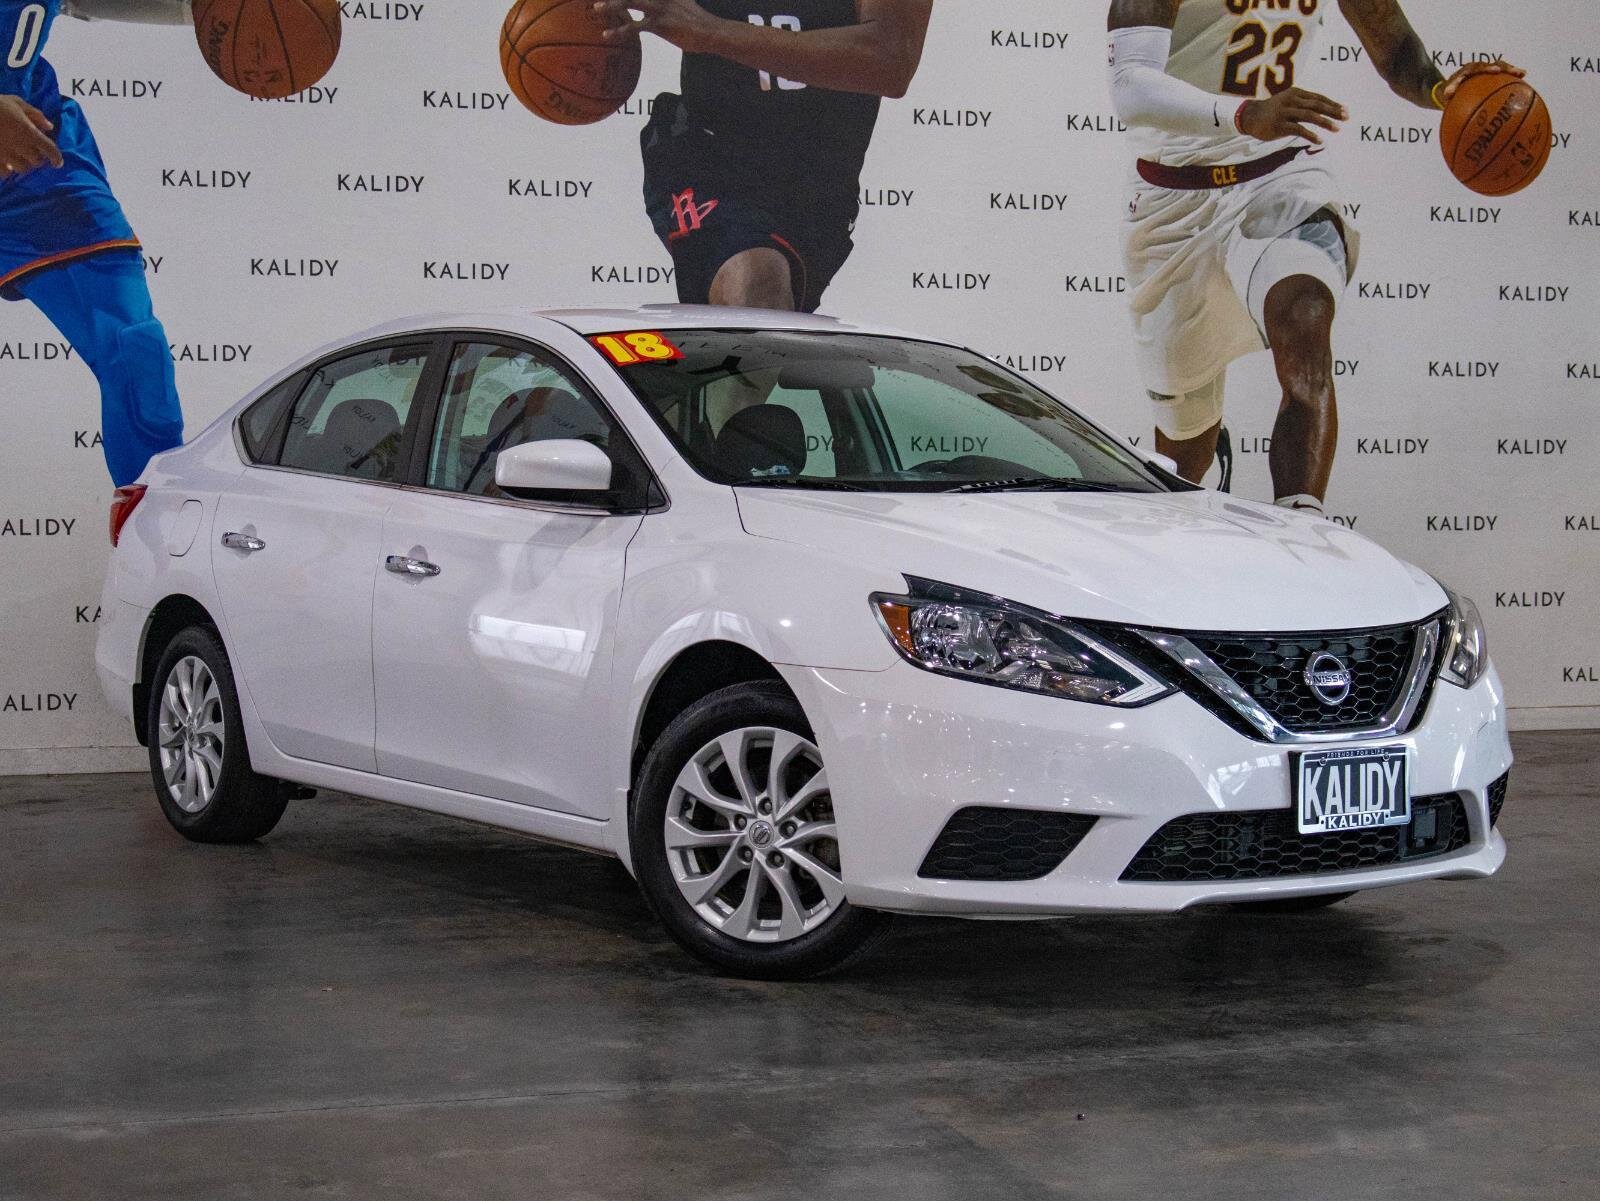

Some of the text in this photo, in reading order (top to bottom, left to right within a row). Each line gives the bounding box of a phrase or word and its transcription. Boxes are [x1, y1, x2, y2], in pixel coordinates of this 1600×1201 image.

[340, 1, 425, 22] KALIDY
[7, 3, 46, 68] 0
[991, 29, 1069, 49] KALIDY
[1220, 20, 1303, 98] 23
[1320, 45, 1362, 63] IDY
[71, 79, 163, 98] KALIDY
[250, 87, 338, 104] IDY
[423, 90, 510, 111] KALIDY
[913, 108, 992, 128] KALIDY
[1360, 125, 1433, 144] KALIDY
[162, 168, 252, 189] KALIDY
[337, 173, 425, 193] KALIDY
[1212, 167, 1237, 185] CLE
[508, 178, 593, 198] KALIDY
[859, 189, 915, 206] LIDY
[990, 192, 1068, 211] KALIDY
[1430, 206, 1502, 224] KALIDY
[1568, 210, 1600, 227] KAL
[250, 258, 339, 277] KALIDY
[423, 261, 510, 281] KALIDY
[591, 265, 673, 284] KALIDY
[912, 272, 991, 291] KALIDY
[1065, 275, 1126, 293] KALID
[1358, 282, 1431, 299] KALIDY
[1499, 285, 1569, 302] KALIDY
[0, 342, 73, 361] ALIDY
[596, 332, 675, 363] 18
[991, 355, 1066, 372] ALIDY
[1428, 361, 1500, 378] KALIDY
[1566, 363, 1600, 379] KAL
[910, 435, 989, 453] KALIDY
[1241, 437, 1271, 453] LID
[1357, 438, 1430, 455] KALIDY
[1497, 439, 1567, 455] KALIDY
[1, 518, 76, 536] ALIDY
[1426, 515, 1498, 532] KALIDY
[1564, 515, 1600, 531] KAL
[1495, 591, 1566, 608] KALIDY
[1312, 674, 1348, 684] NISSAN
[1563, 666, 1599, 683] KAL
[2, 692, 78, 712] ALIDY
[1304, 761, 1401, 820] KALIDY
[1328, 812, 1382, 829] KALIDY
